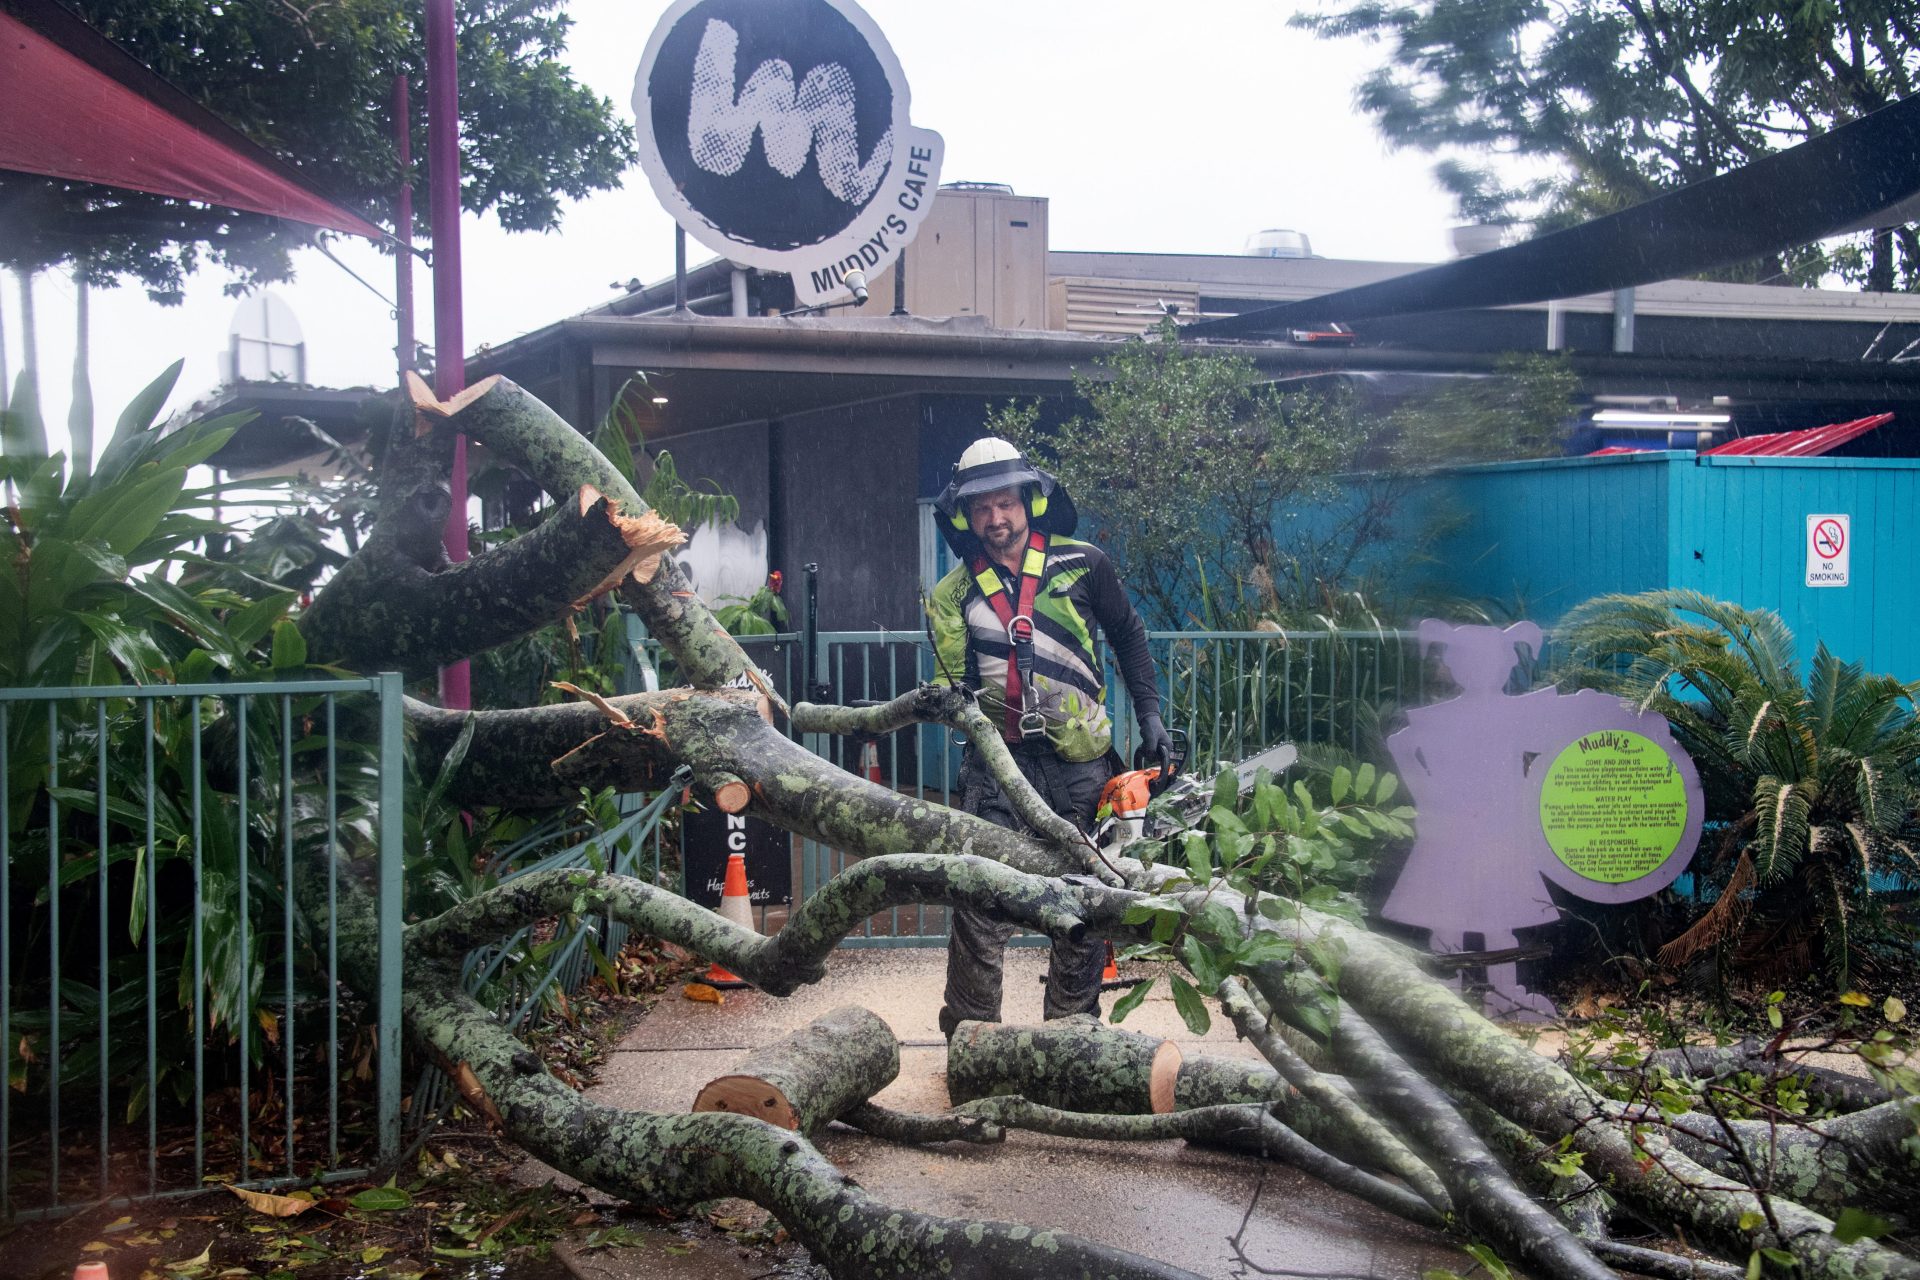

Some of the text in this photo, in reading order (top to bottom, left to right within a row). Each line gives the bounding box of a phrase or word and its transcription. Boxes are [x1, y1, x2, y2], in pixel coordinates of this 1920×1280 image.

[811, 146, 932, 294] MUDDY'S CAFE
[1822, 562, 1834, 571] NO
[1810, 573, 1845, 581] SMOKING
[1578, 732, 1629, 754] Muddy's
[1598, 838, 1638, 846] RESPONSIBLE
